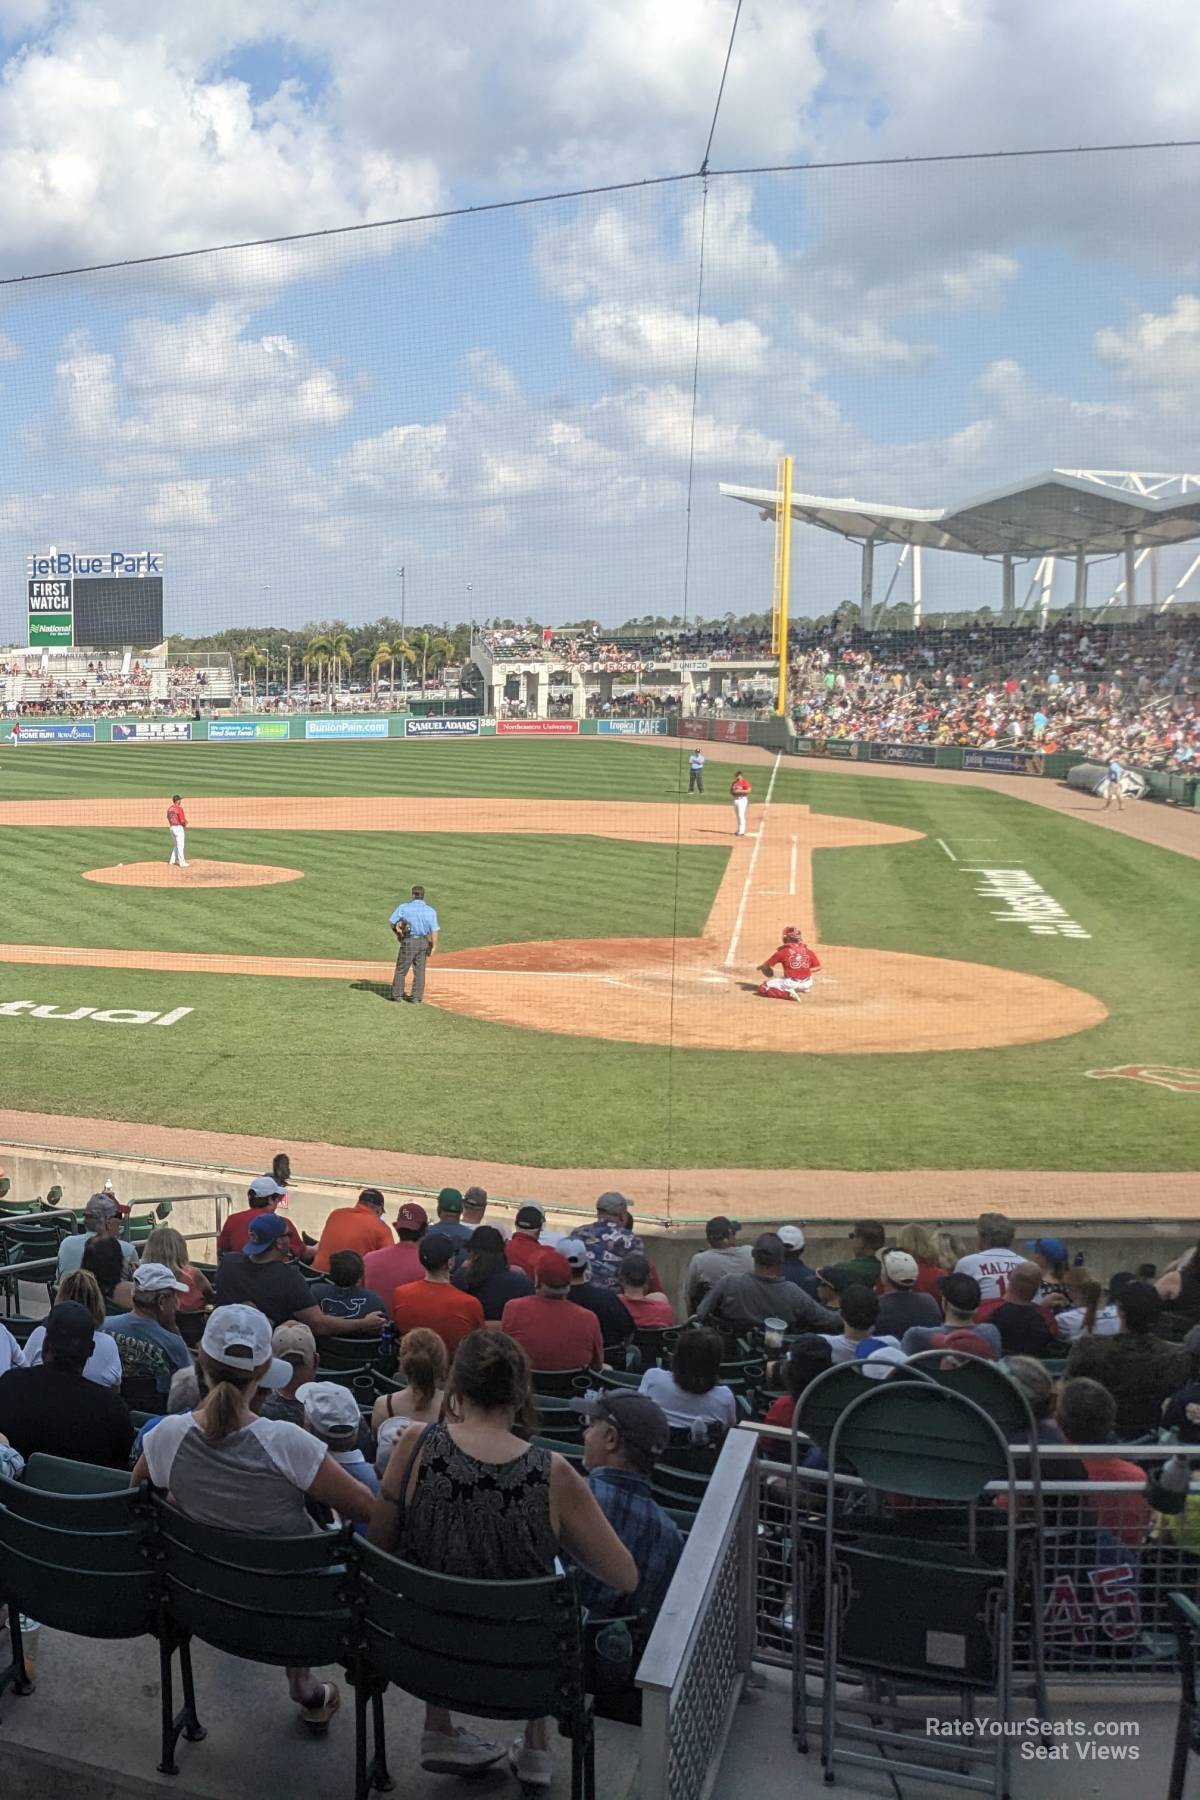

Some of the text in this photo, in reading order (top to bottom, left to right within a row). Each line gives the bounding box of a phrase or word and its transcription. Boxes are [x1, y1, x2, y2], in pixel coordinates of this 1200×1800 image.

[31, 552, 158, 578] jetBlue Park
[34, 583, 66, 596] FIRST
[30, 596, 68, 610] WATCH
[39, 624, 71, 632] National
[136, 724, 188, 732] BEST
[310, 722, 384, 732] BunionPain.com
[408, 720, 477, 732] SAMUEL ADAMS
[480, 718, 495, 727] 380
